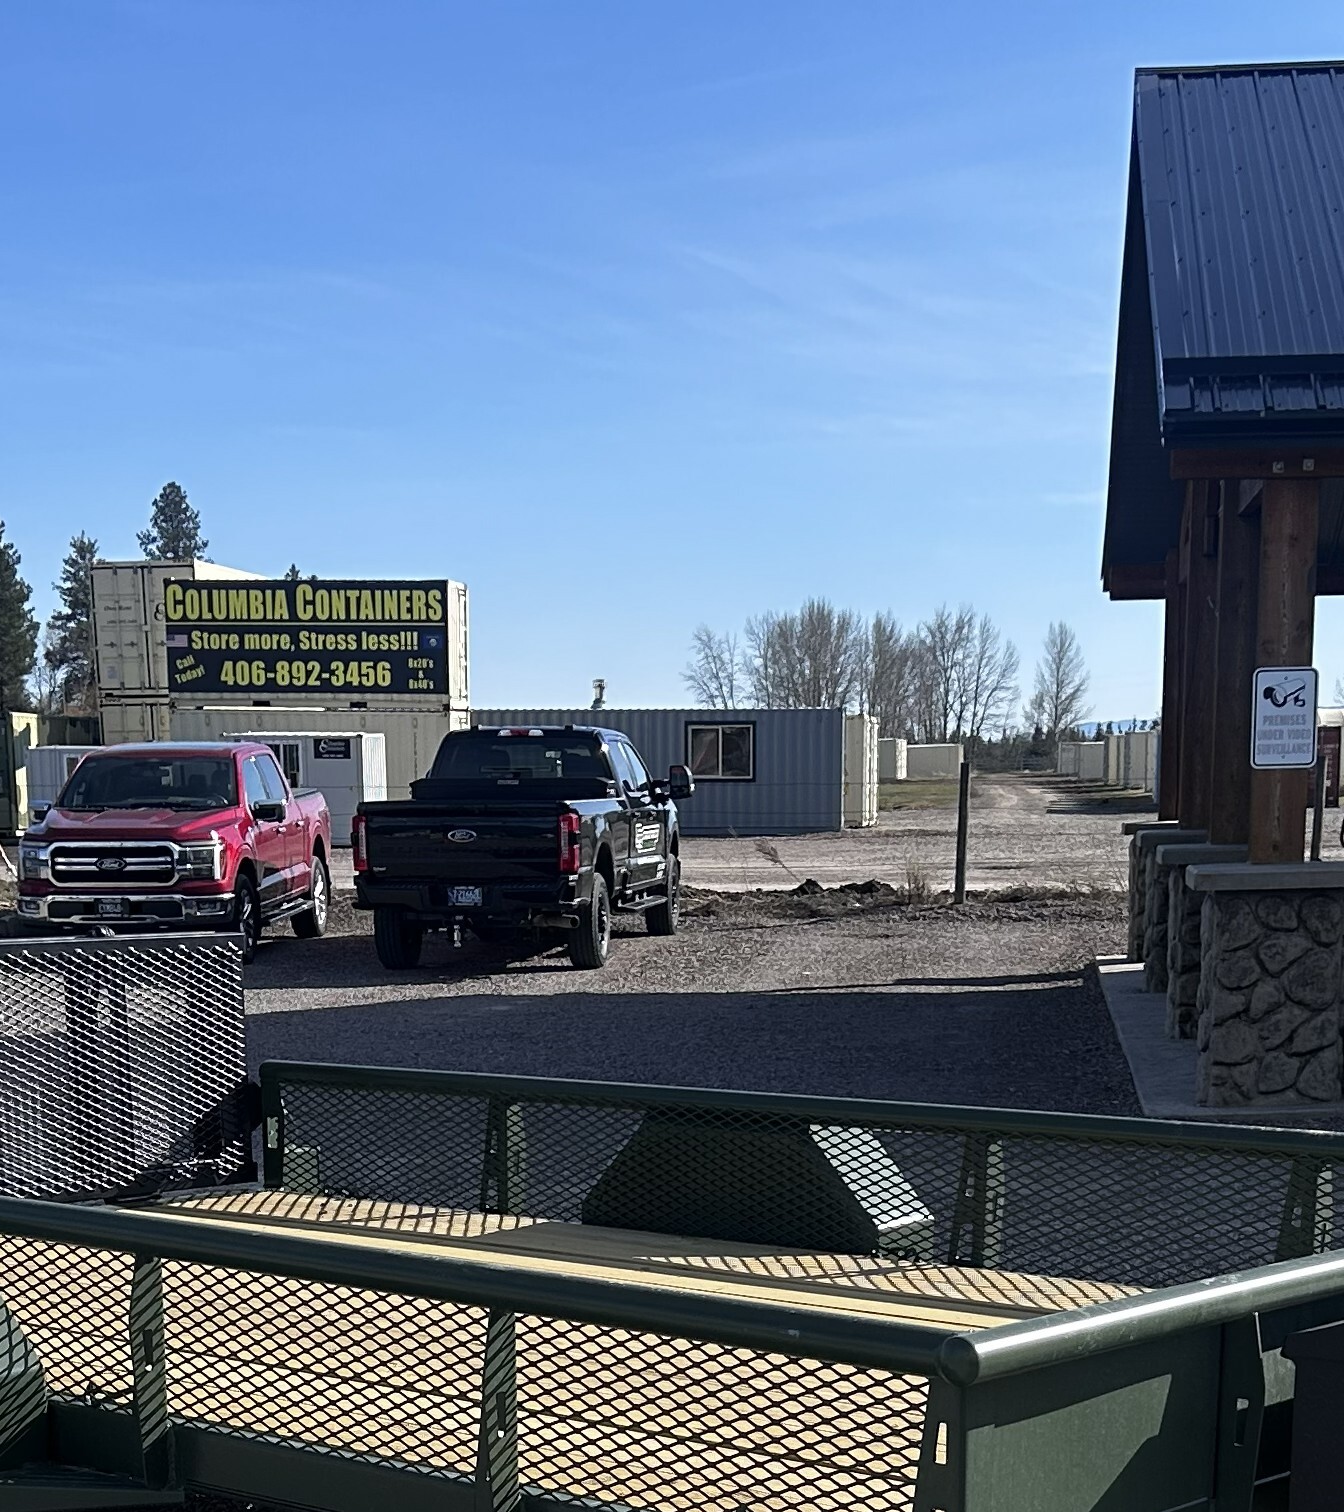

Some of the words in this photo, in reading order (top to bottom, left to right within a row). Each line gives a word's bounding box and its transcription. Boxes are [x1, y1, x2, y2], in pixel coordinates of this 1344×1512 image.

[166, 584, 289, 620] COLUMBIA
[296, 584, 442, 620] CONTAINERS
[191, 631, 239, 650] Store
[244, 633, 295, 651] more,
[299, 631, 357, 650] Stress
[361, 631, 418, 650] less!!!
[176, 655, 195, 669] Call
[220, 660, 391, 686] 406-892-3456
[1263, 714, 1306, 726] PREMISES
[1257, 729, 1284, 741] UNDER
[1287, 728, 1312, 740] VIDEO
